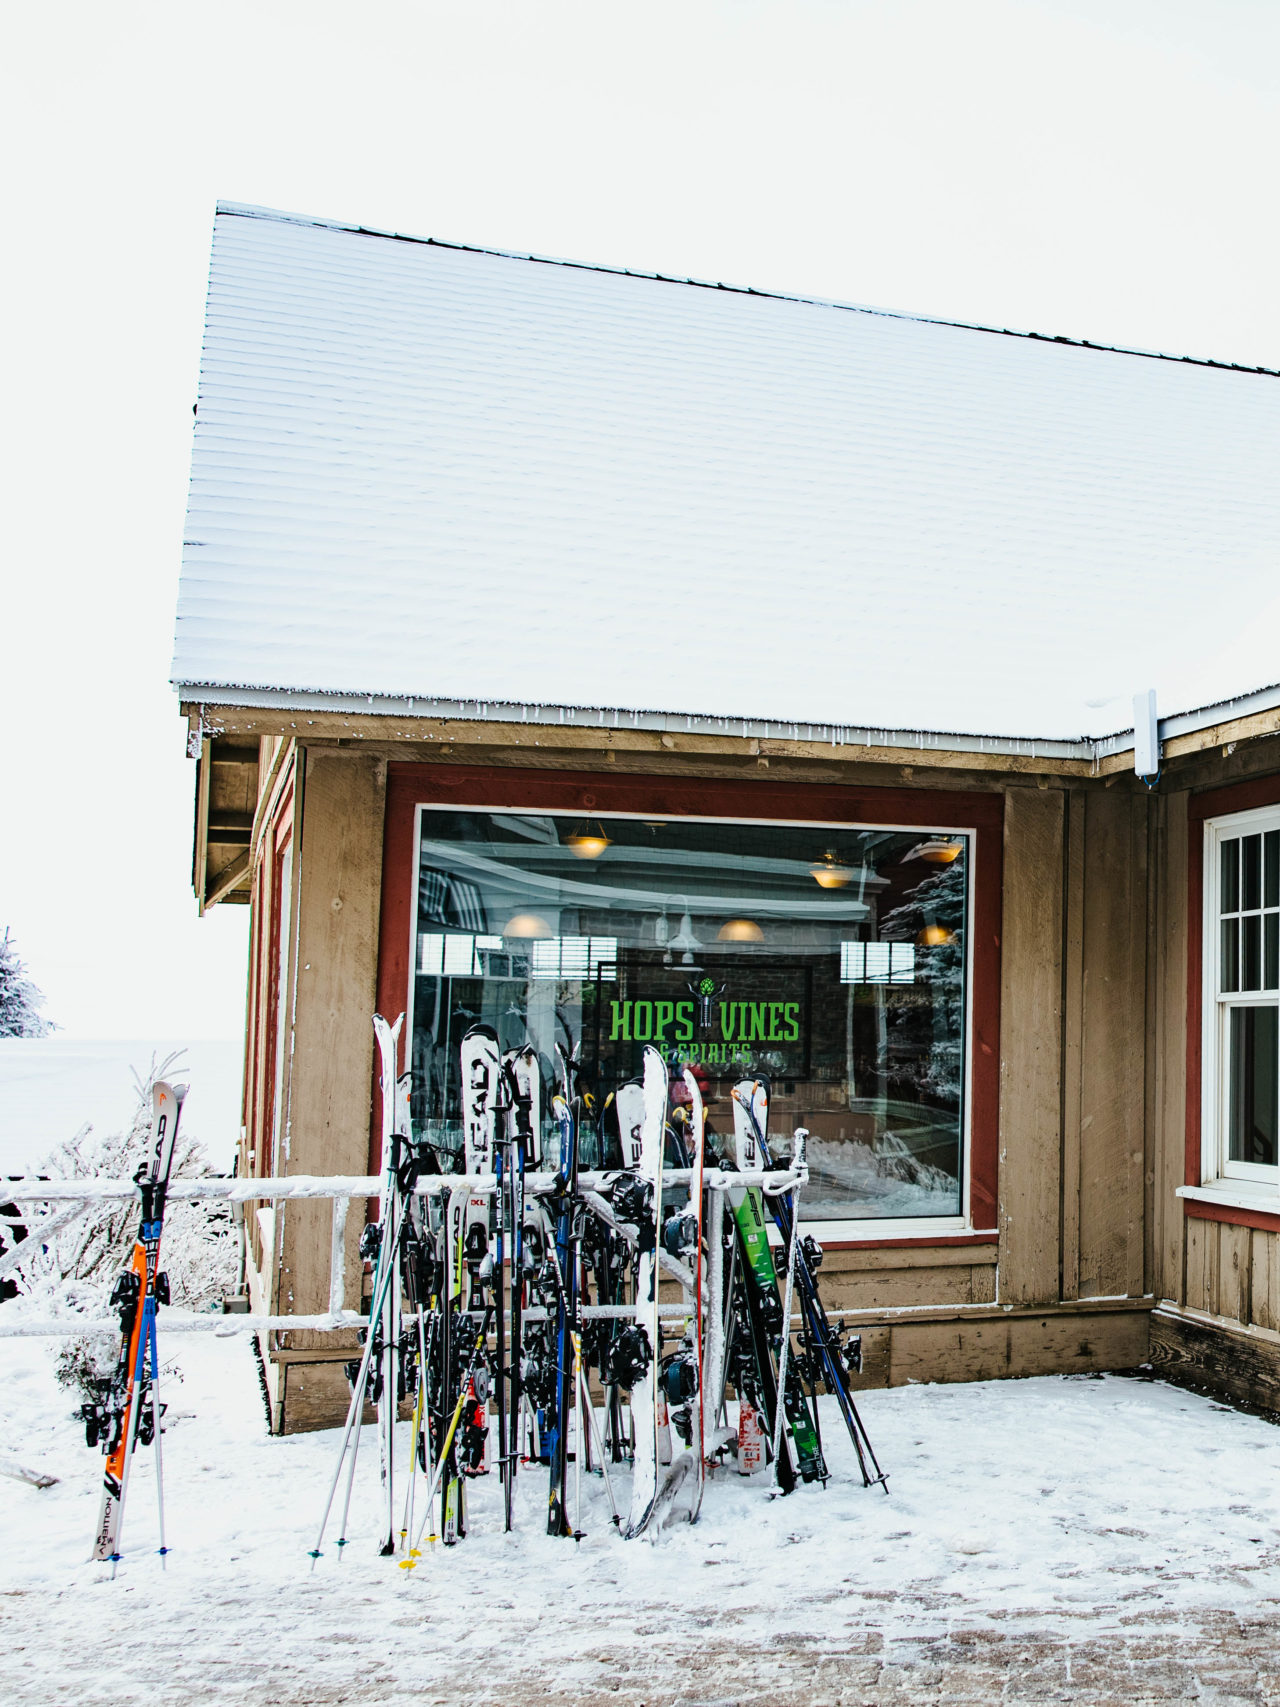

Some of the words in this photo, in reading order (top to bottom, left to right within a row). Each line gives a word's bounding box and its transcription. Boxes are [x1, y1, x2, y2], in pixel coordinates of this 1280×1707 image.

[608, 1000, 694, 1041] HOPS
[718, 1002, 800, 1041] VINES
[677, 1043, 750, 1064] SPIRITS
[152, 1116, 167, 1179] EAD
